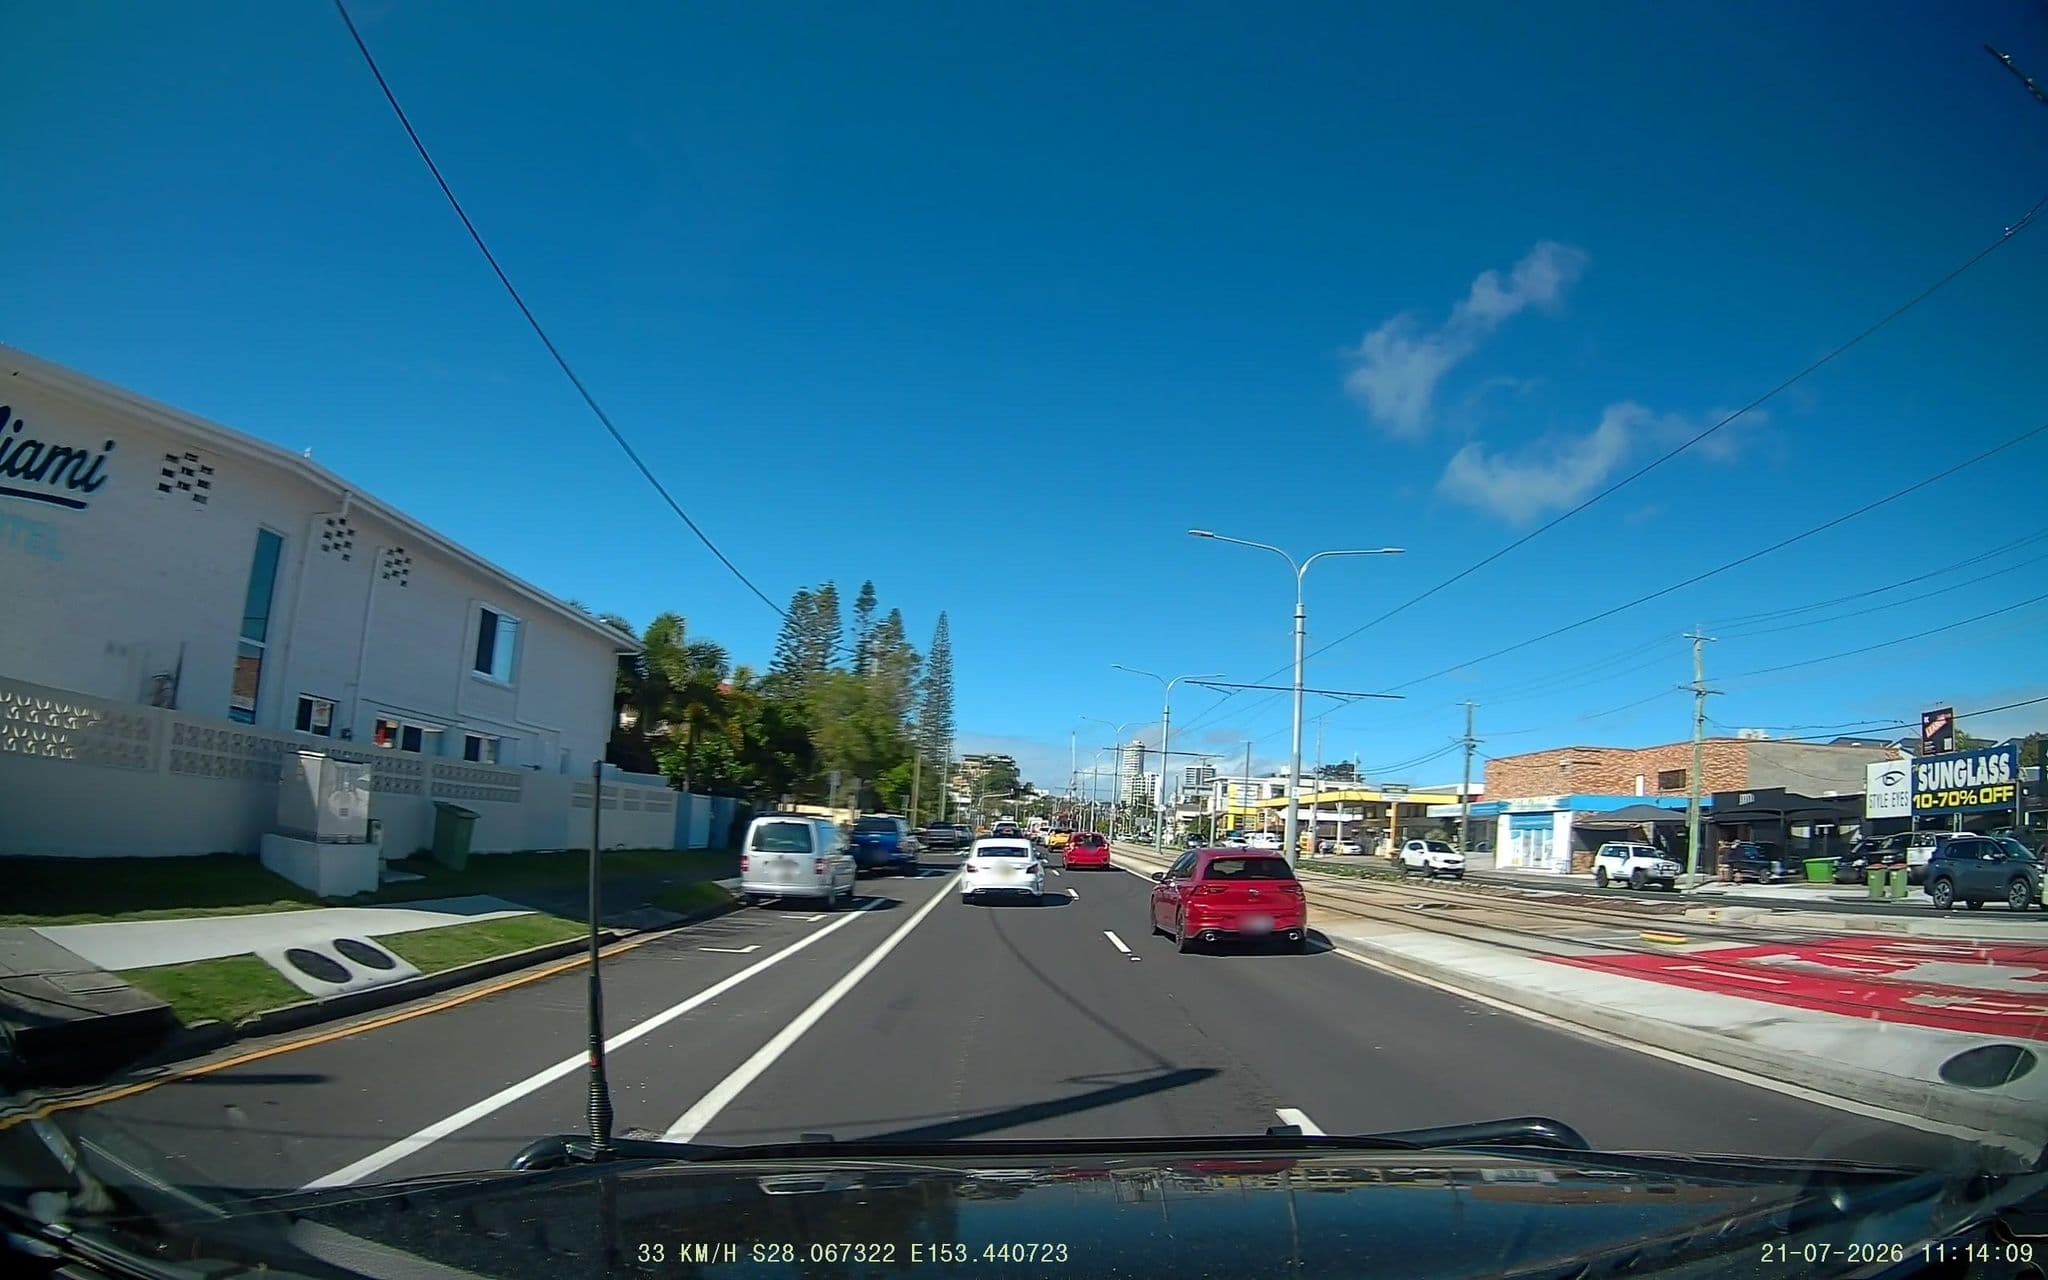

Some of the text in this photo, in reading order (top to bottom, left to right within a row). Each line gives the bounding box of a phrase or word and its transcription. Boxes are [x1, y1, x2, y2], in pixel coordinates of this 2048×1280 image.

[1917, 752, 2011, 792] SUNGLASS
[1868, 790, 1910, 809] STYLE EYES
[1912, 785, 2015, 810] 10-70% OFF
